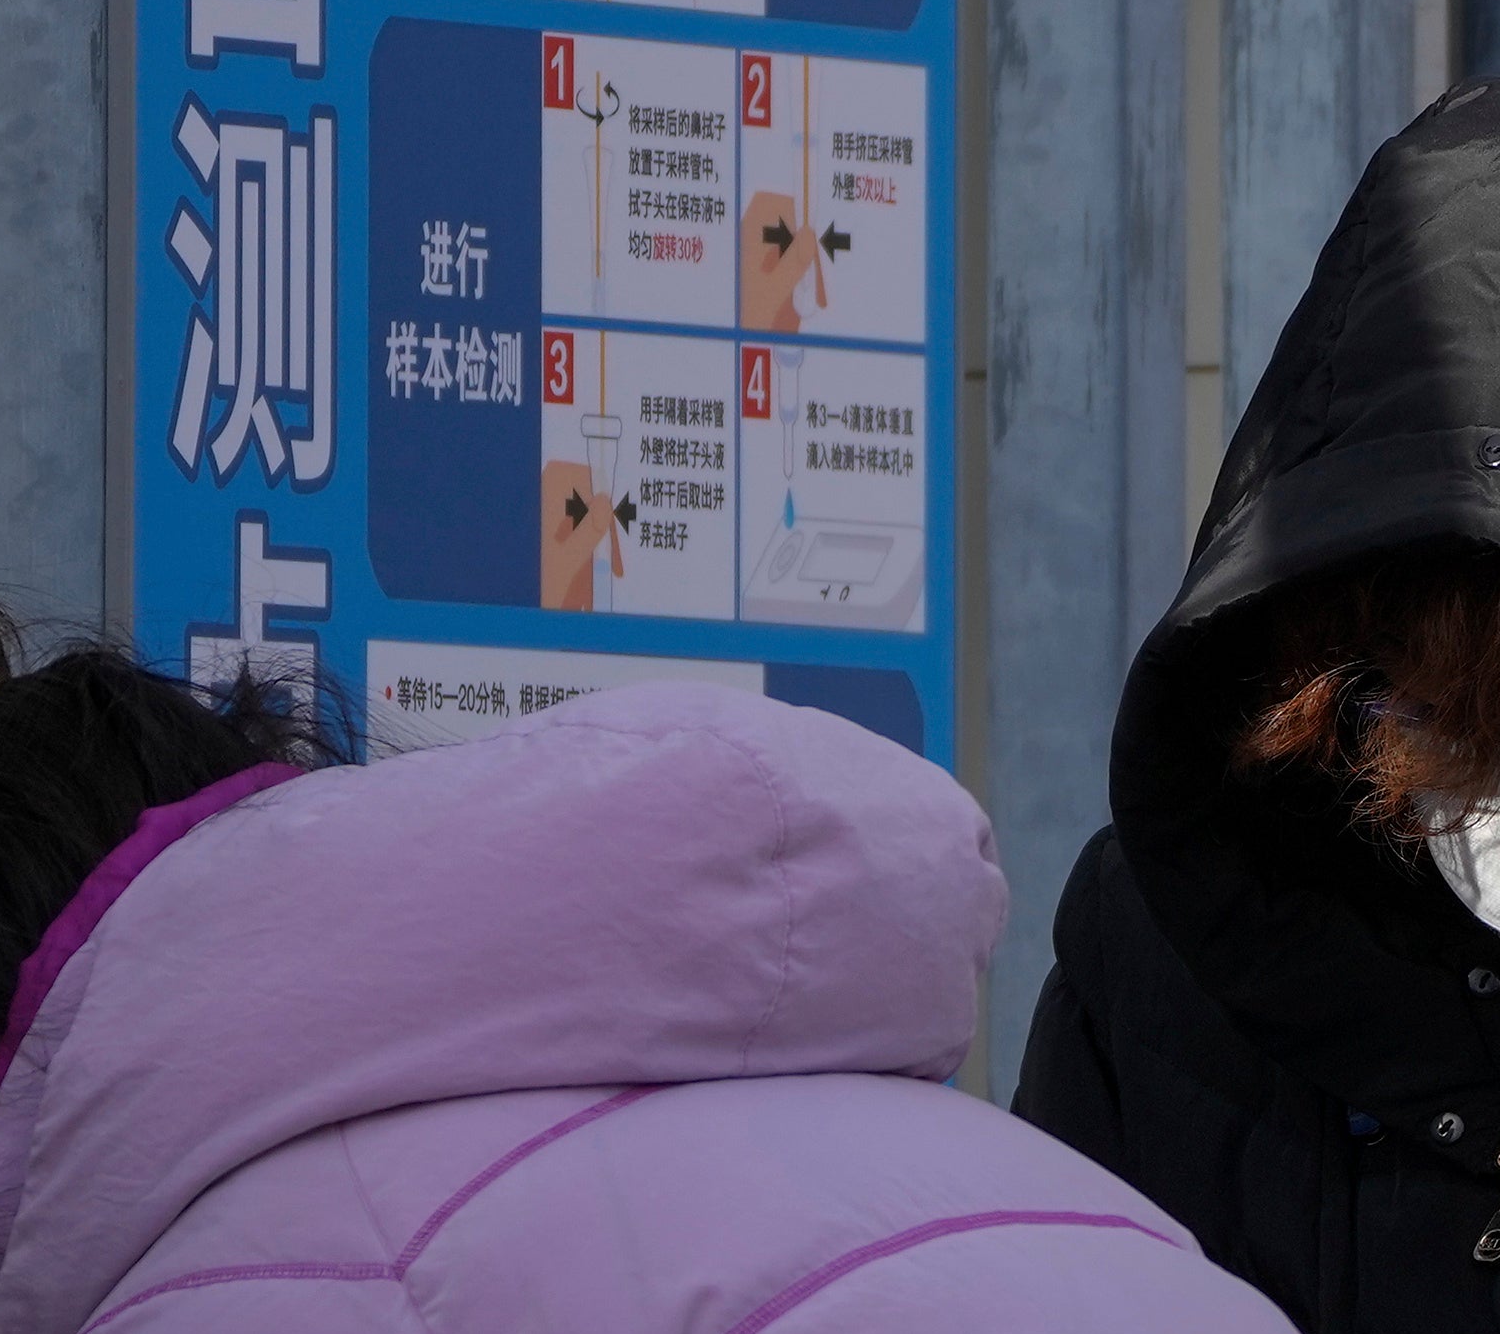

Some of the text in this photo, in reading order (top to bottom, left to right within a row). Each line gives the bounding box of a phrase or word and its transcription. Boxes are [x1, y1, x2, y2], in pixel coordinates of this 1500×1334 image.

[550, 46, 567, 101] 1
[745, 62, 767, 122] 2
[628, 103, 727, 142] 将采样后的鼻拭子
[628, 147, 720, 184] 放置于采样管中，
[832, 131, 914, 167] 用手挤压采样管
[628, 188, 726, 225] 拭子头在保存液中
[832, 170, 897, 206] 外壁5次以上
[420, 221, 489, 301] 进行
[628, 230, 704, 264] 均匀旋转30秒
[386, 321, 523, 408] 样本检测
[548, 341, 569, 398] 3
[745, 354, 767, 412] 4
[639, 395, 725, 429] 用手隔着采样管
[639, 435, 725, 472] 外壁将拭子头液
[806, 441, 914, 477] 滴入检测卡样本孔中
[639, 480, 725, 512] 体挤干后取出并
[639, 521, 689, 553] 弃去拭子
[396, 675, 601, 718] 等待15—20分钟，根据相
